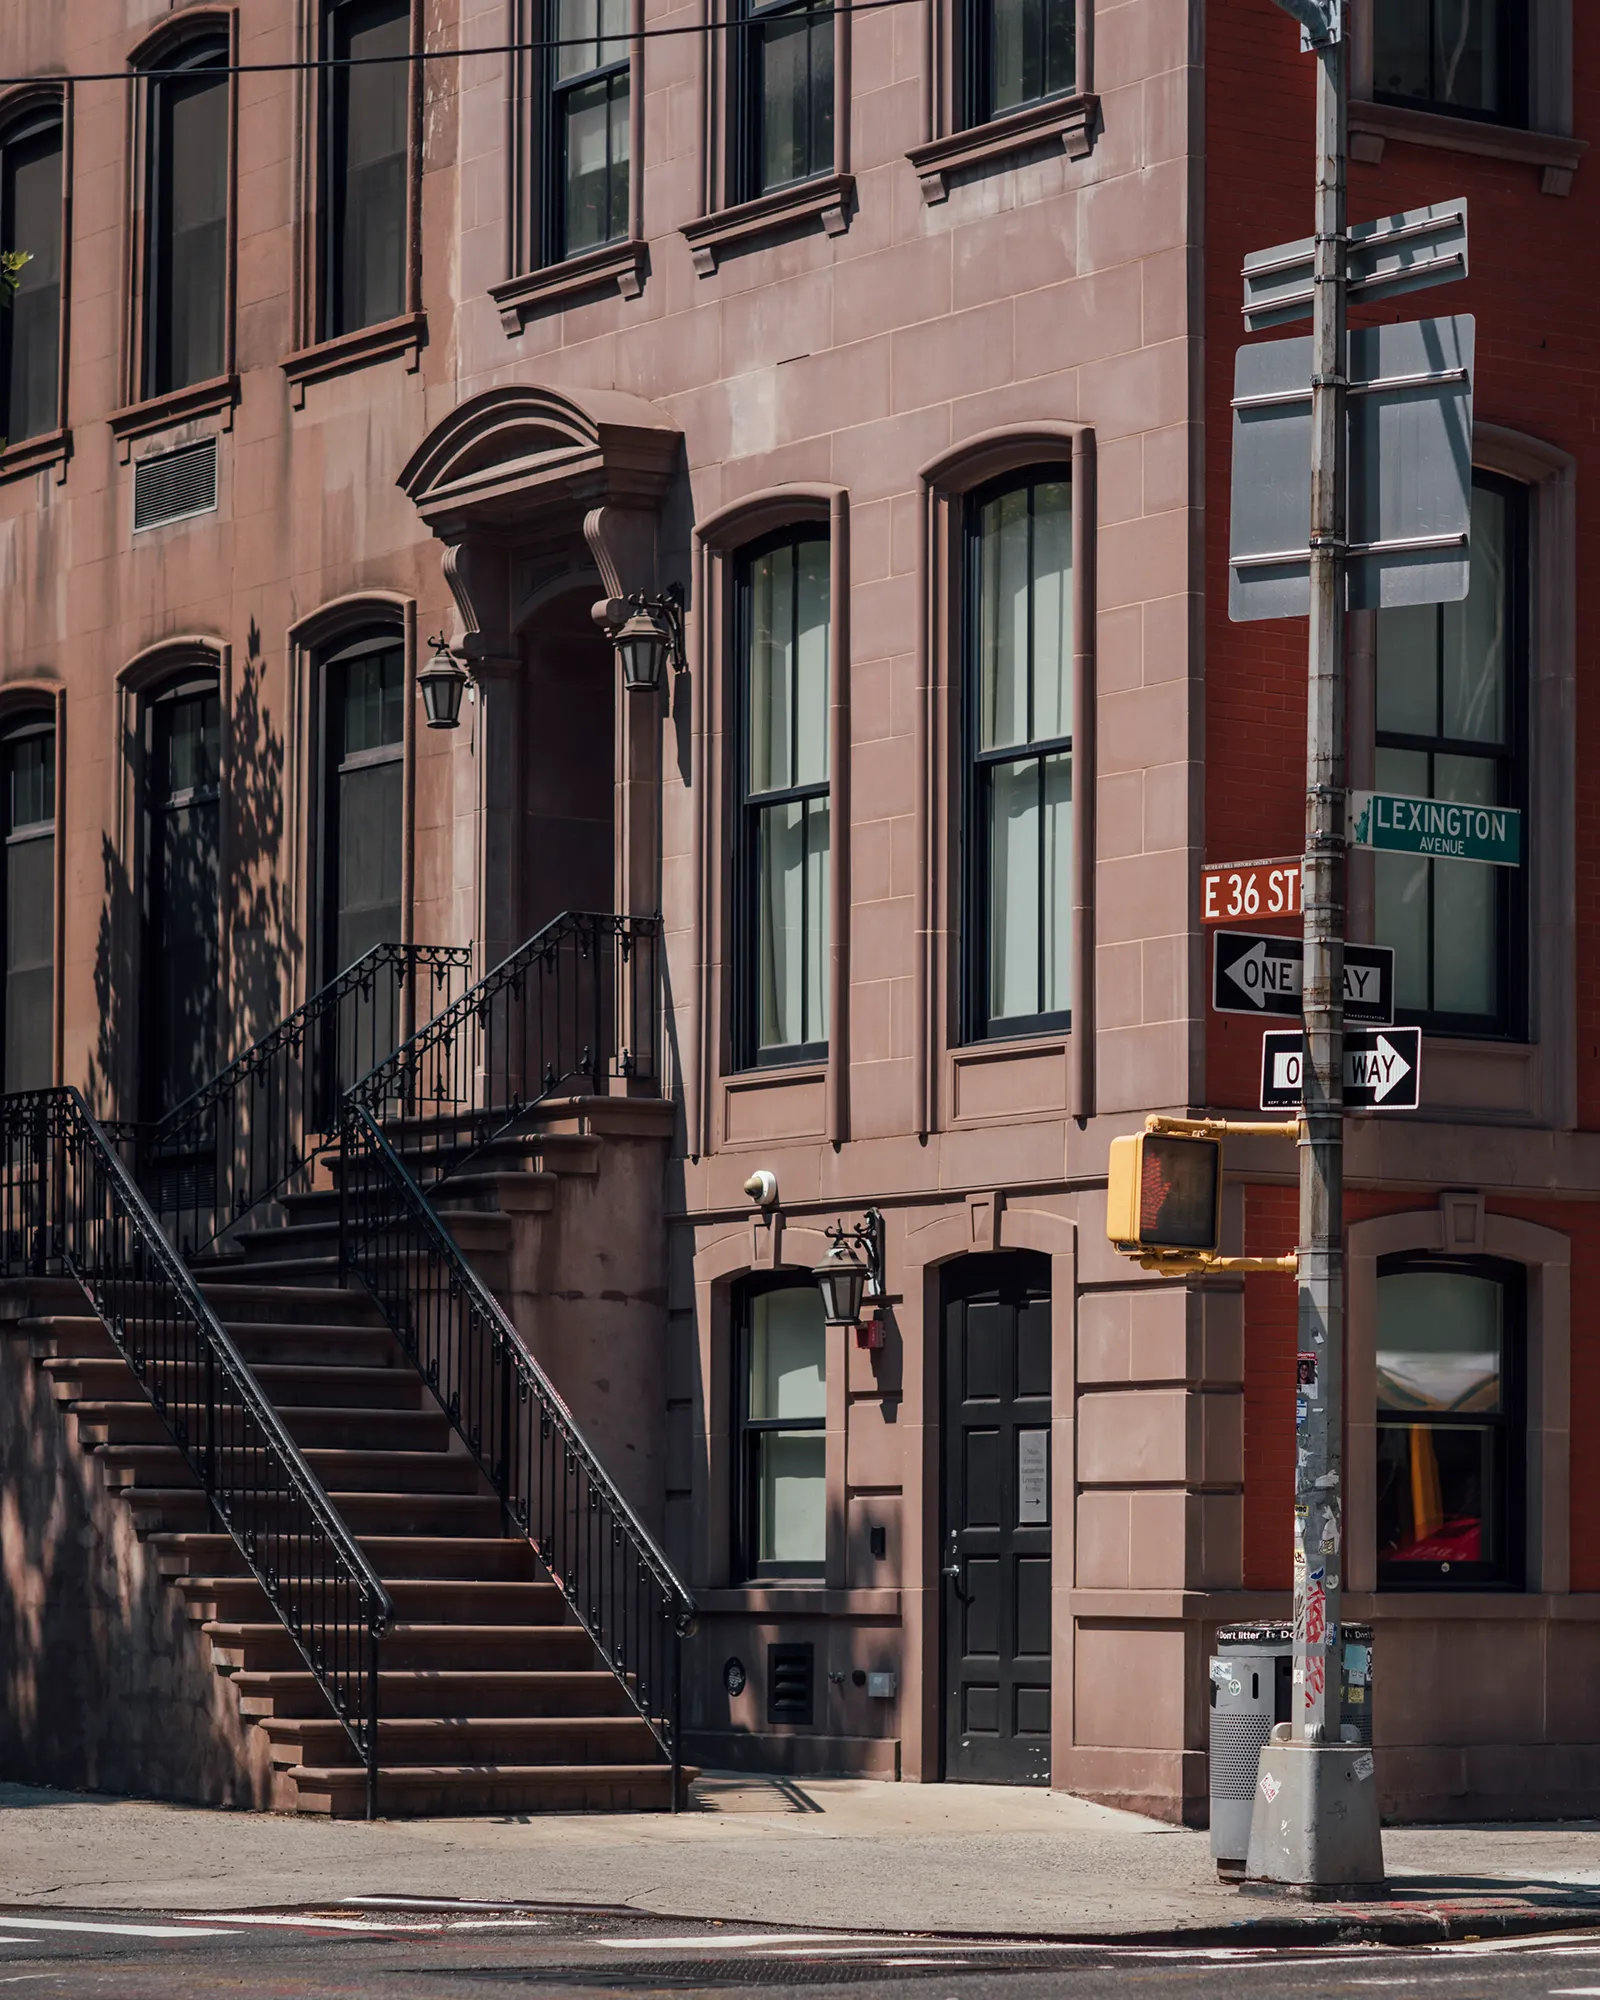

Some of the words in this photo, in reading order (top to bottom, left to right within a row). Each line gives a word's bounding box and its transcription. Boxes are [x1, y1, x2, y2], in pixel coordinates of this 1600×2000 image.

[1377, 799, 1506, 842] LEXINGTON
[1419, 836, 1465, 855] AVENUE
[1205, 875, 1220, 918] E
[1227, 873, 1260, 916] 36
[1267, 869, 1299, 913] ST
[1244, 958, 1293, 992] ONE
[1343, 968, 1371, 998] AY
[1352, 1054, 1396, 1084] WAY
[1219, 1631, 1236, 1640] Don't
[1238, 1631, 1261, 1640] litter
